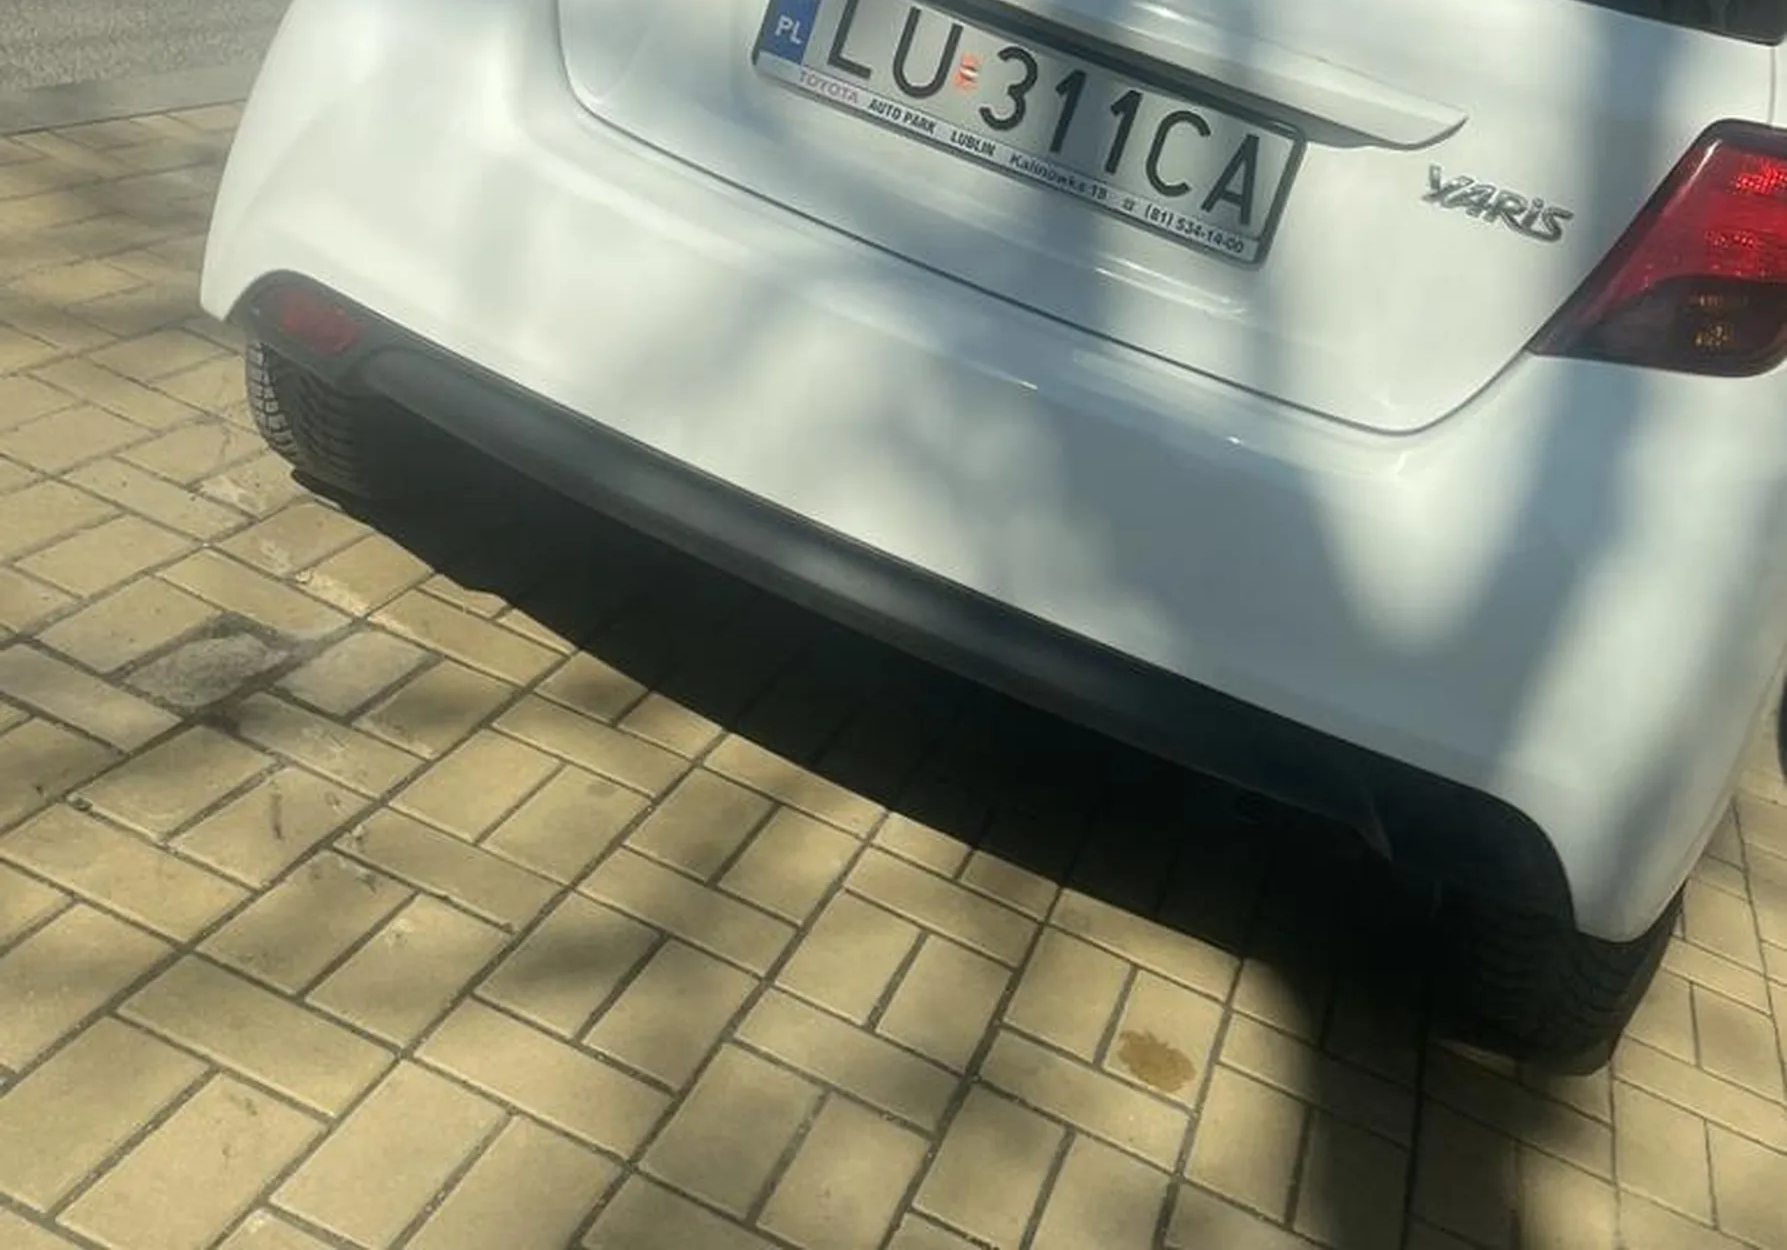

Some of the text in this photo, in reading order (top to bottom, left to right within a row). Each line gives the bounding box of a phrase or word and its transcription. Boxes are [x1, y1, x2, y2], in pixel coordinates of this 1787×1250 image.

[774, 13, 804, 46] PL
[799, 70, 861, 104] TOYOTA
[867, 98, 903, 122] AUTO
[902, 110, 938, 135] PARK
[950, 130, 998, 157] LUBLIN
[1143, 202, 1173, 228] (81)
[978, 45, 1260, 225] 311CA
